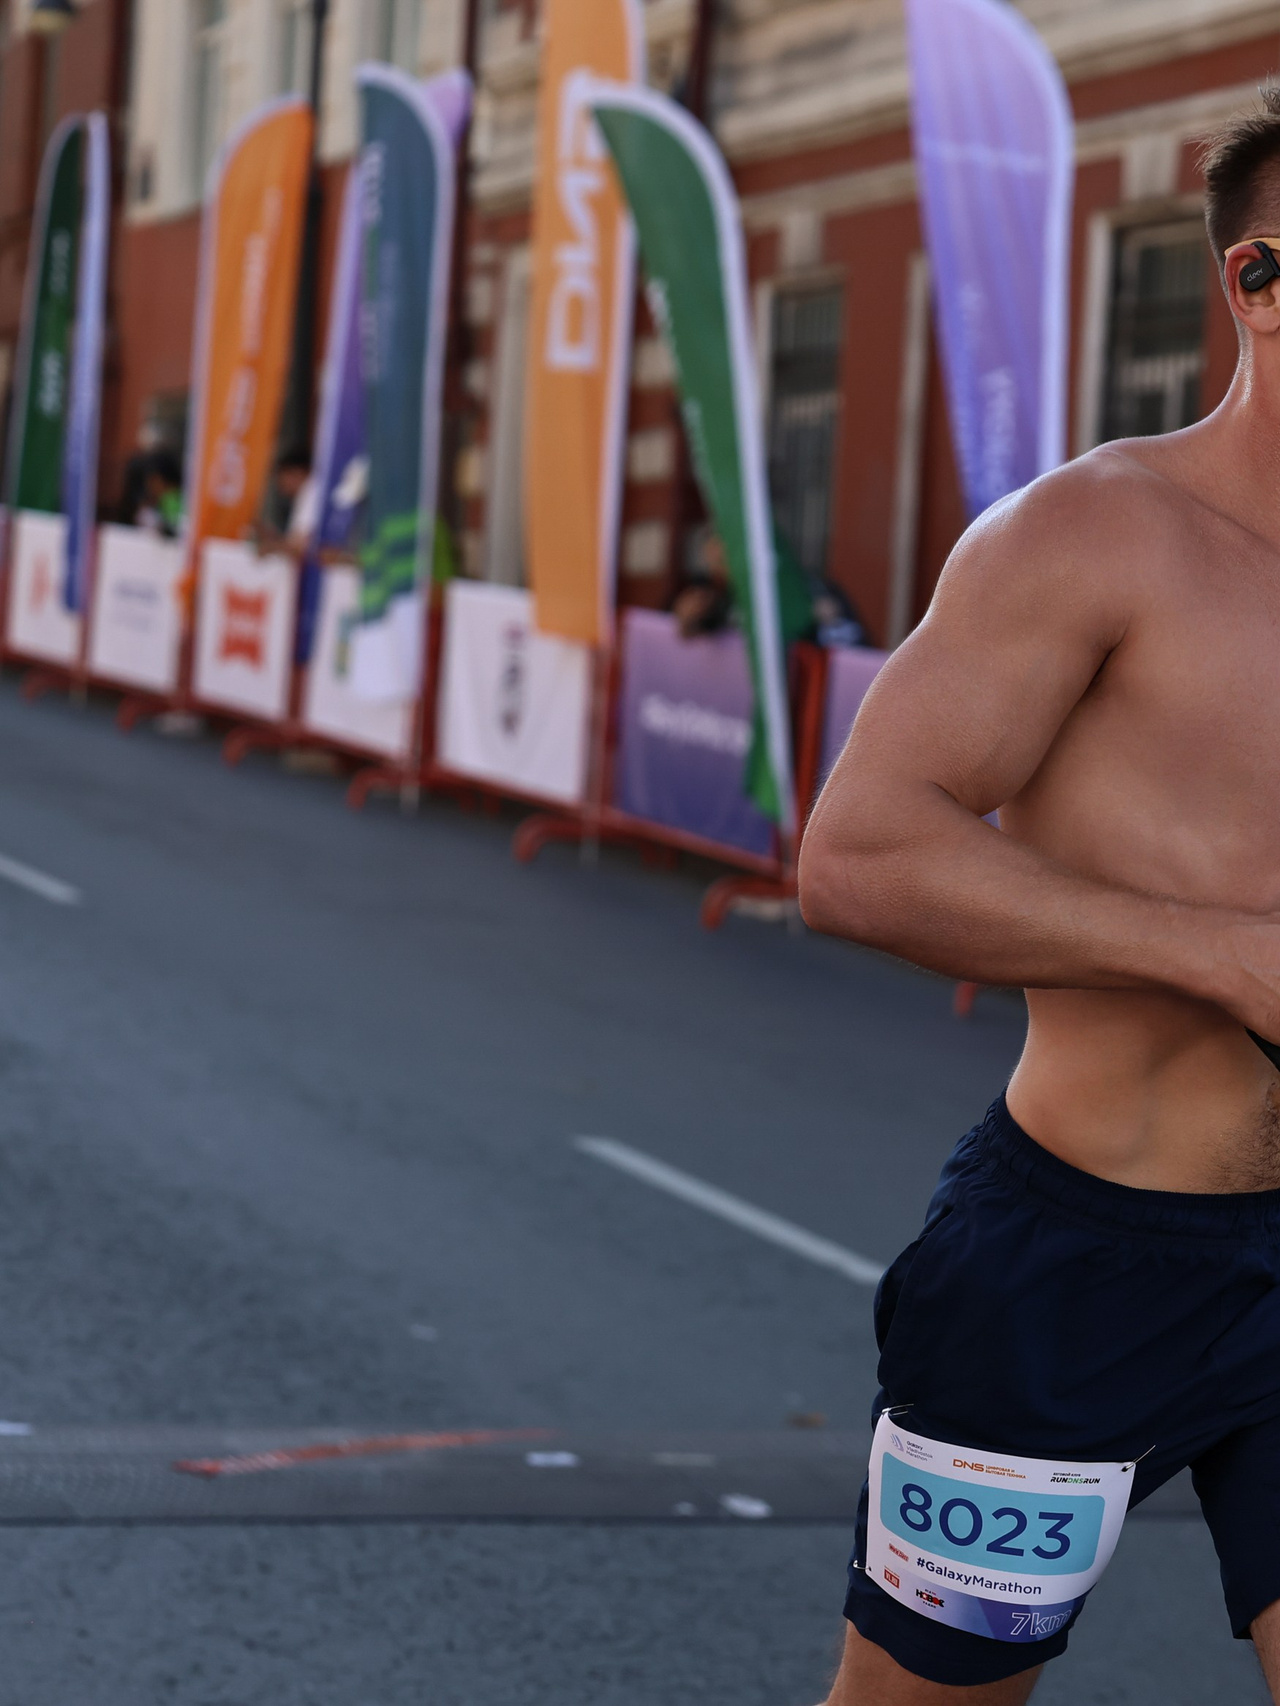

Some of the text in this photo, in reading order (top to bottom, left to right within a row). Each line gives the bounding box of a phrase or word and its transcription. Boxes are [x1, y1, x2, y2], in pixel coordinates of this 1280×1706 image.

[952, 1458, 985, 1473] DNS
[1050, 1476, 1101, 1485] RUNDNSRUN
[899, 1483, 1074, 1560] 8023
[916, 1556, 1042, 1595] #GalaxyMarathon
